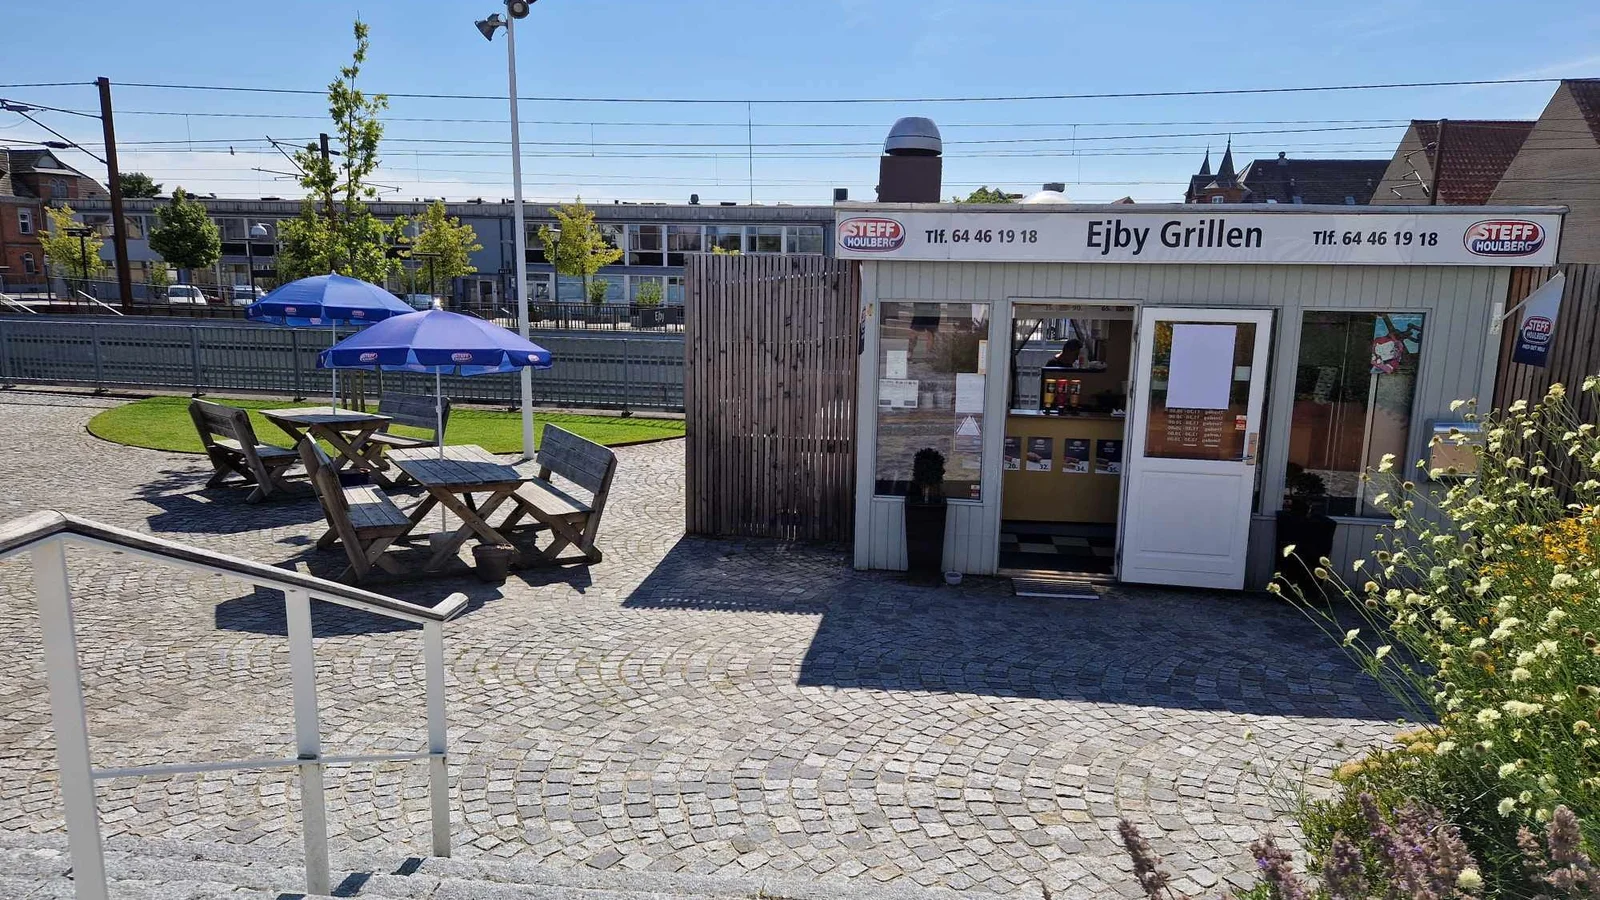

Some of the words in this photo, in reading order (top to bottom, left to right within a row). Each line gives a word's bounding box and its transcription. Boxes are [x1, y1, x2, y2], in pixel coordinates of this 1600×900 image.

[848, 221, 896, 236] STEFF
[1480, 223, 1534, 240] STEFF
[847, 236, 896, 248] HOULBERG
[925, 229, 948, 243] Tlf.
[952, 229, 971, 243] 64
[974, 229, 992, 243] 46
[997, 229, 1015, 243] 19
[1020, 229, 1038, 243] 18
[1087, 220, 1150, 255] Ejby
[1160, 218, 1263, 248] Grillen
[1313, 231, 1337, 245] Tlf.
[1342, 231, 1362, 245] 64
[1367, 231, 1387, 245] 46
[1393, 231, 1413, 246] 19
[1418, 232, 1438, 247] 18
[1476, 240, 1534, 252] HOULBERG
[1528, 319, 1549, 332] STEFF
